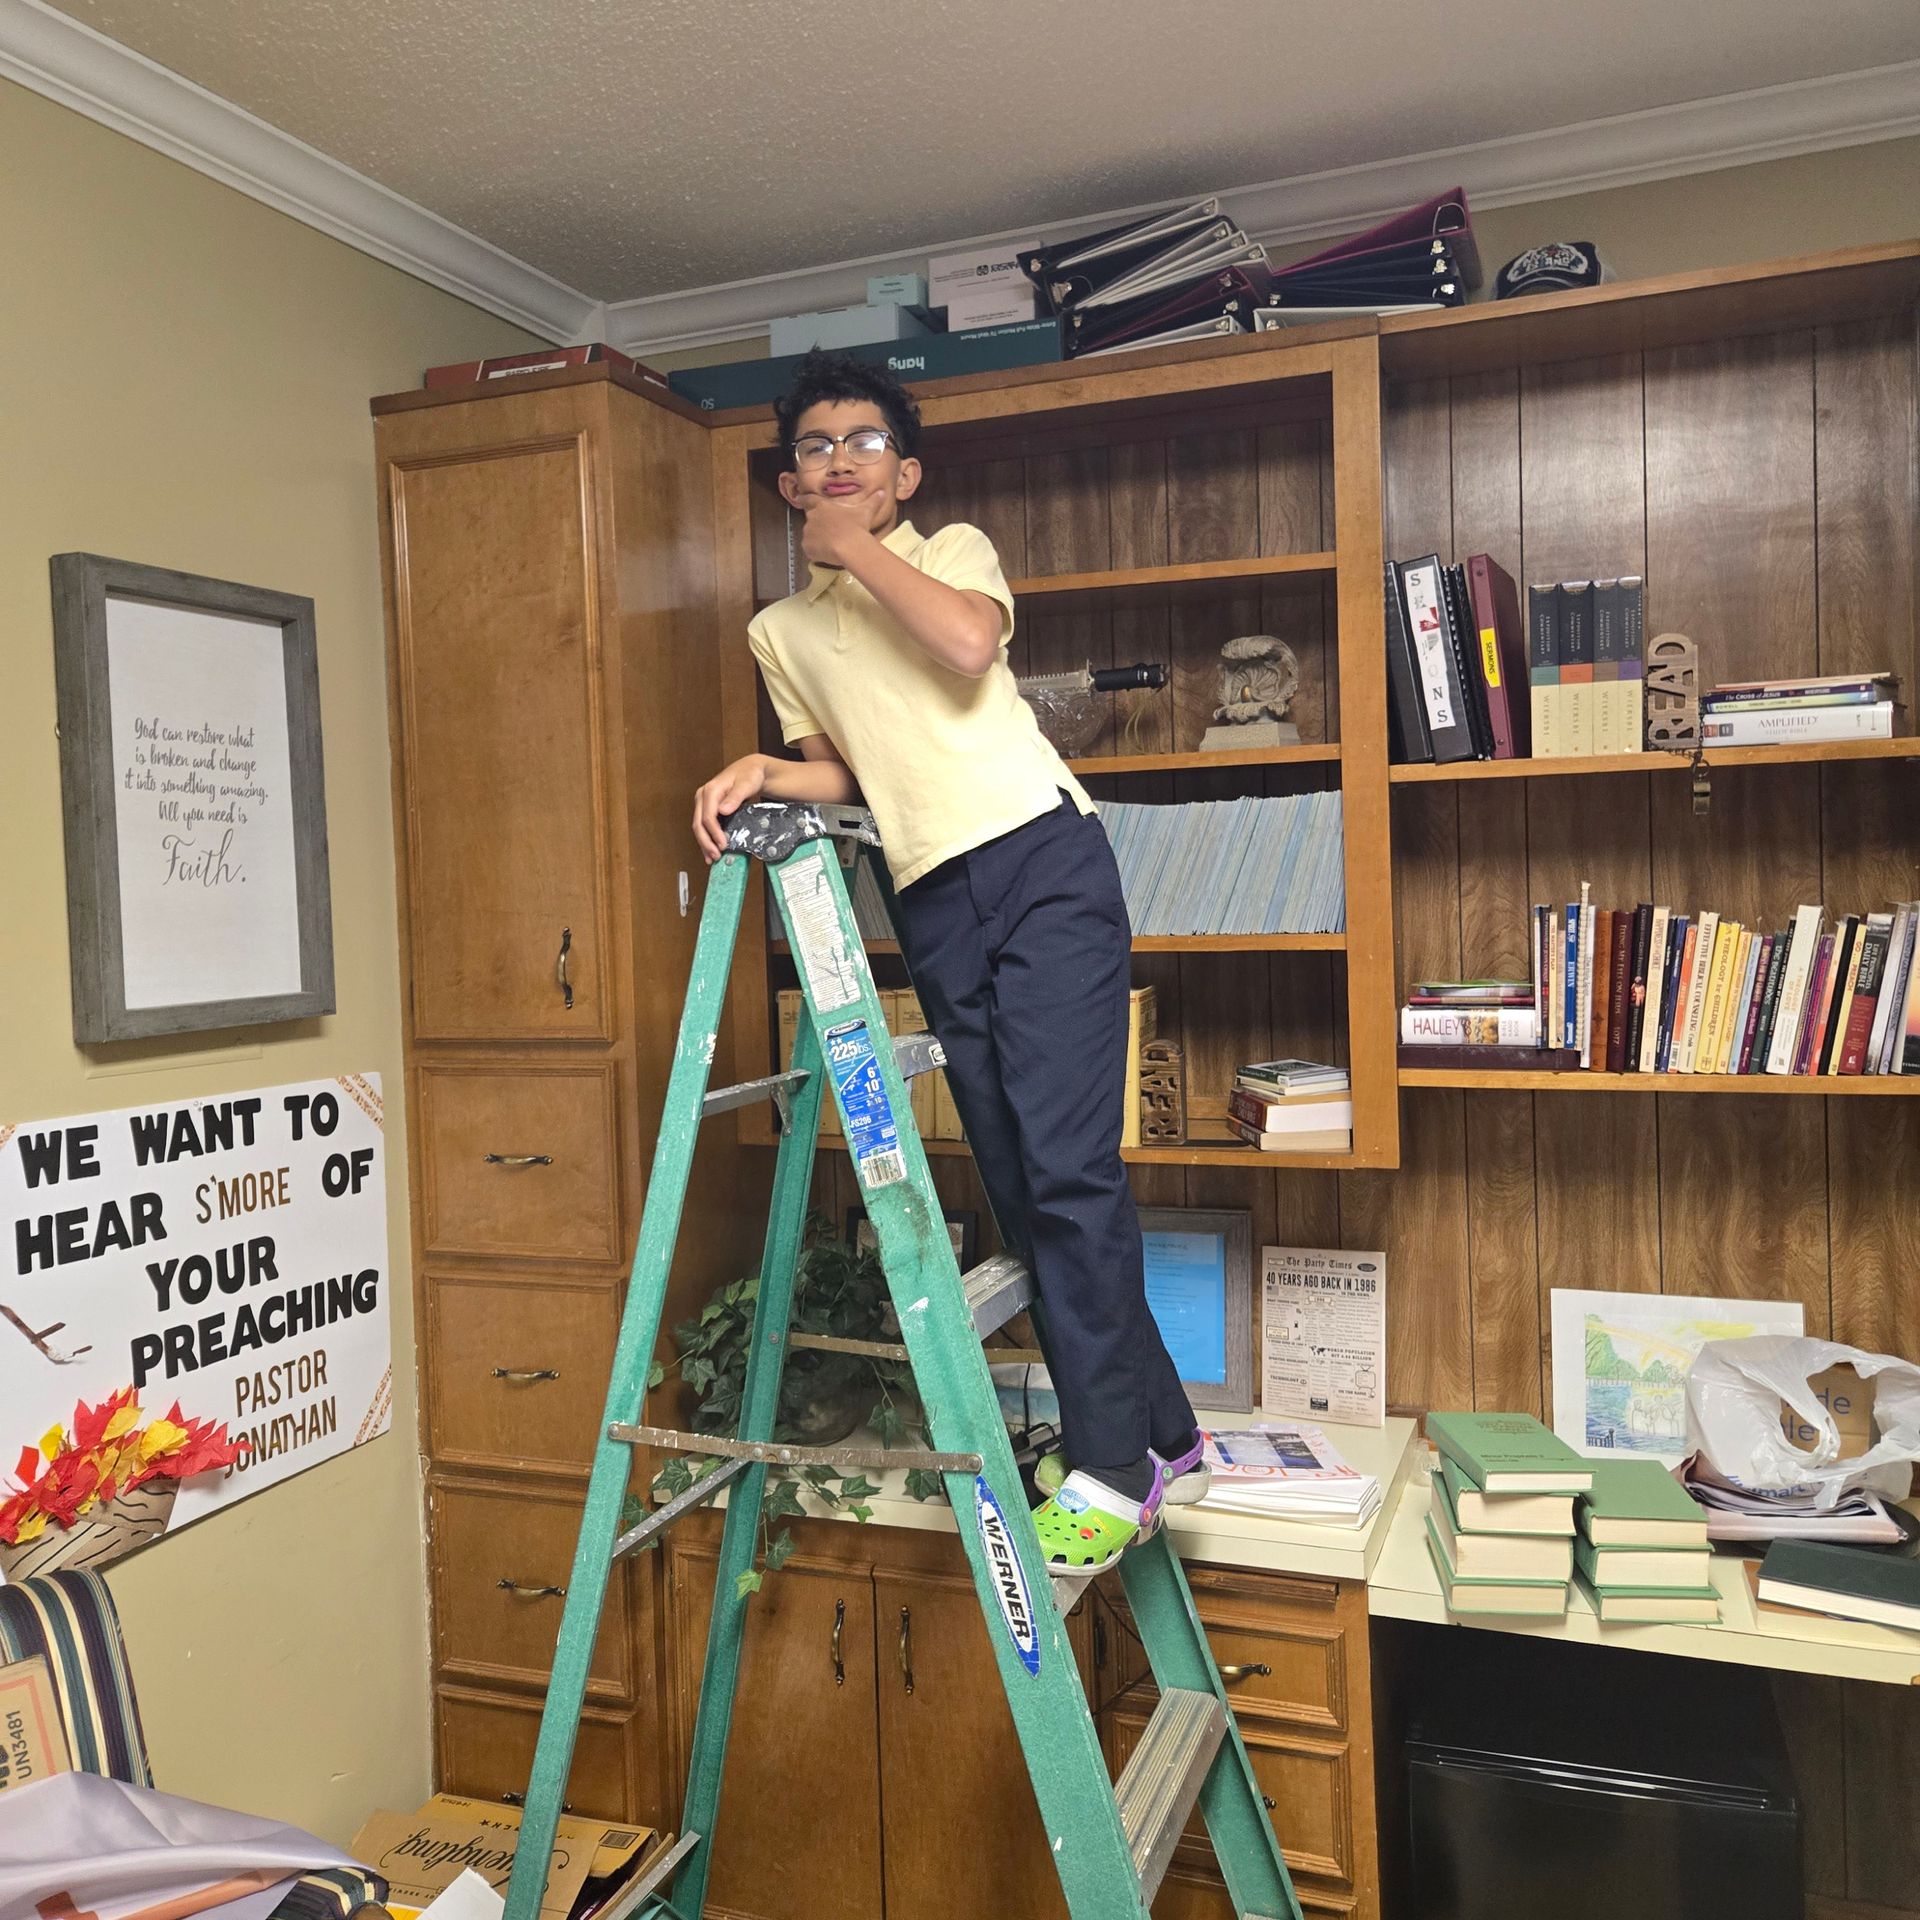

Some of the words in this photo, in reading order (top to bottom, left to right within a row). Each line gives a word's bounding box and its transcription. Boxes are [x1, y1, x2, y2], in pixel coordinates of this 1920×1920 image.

[888, 356, 924, 370] hang
[1485, 642, 1496, 675] SERMONS
[1648, 633, 1699, 747] READ
[135, 717, 160, 740] God
[162, 728, 183, 741] can
[187, 722, 225, 745] restore
[229, 725, 255, 748] what
[1759, 716, 1817, 728] AMPLIFIED
[136, 746, 146, 765] is
[151, 744, 189, 767] broken
[193, 749, 216, 770] and
[220, 749, 256, 780] change
[125, 768, 134, 790] it
[137, 769, 156, 791] into
[161, 772, 216, 803] something
[220, 782, 269, 806] amazing.
[159, 801, 179, 822] All
[183, 803, 204, 830] you
[208, 802, 234, 823] need
[238, 807, 248, 824] is
[163, 828, 246, 887] Faith.
[1618, 950, 1626, 962] MY
[1700, 924, 1712, 959] EFFECTIVE
[1855, 942, 1862, 952] GO
[1862, 942, 1872, 966] DAILY
[1568, 961, 1576, 988] ERWIN
[1696, 961, 1706, 990] BIBLICAL
[1718, 937, 1731, 982] THEOLOGY
[1866, 958, 1878, 990] PRINCIPLES
[1616, 981, 1623, 993] ON
[1857, 968, 1868, 989] BIBLE
[1614, 994, 1622, 1014] JESUS
[1690, 991, 1701, 1031] COUNSELING
[1708, 994, 1720, 1035] CHILDREN
[1413, 1018, 1472, 1036] HALLEY'S
[1140, 1040, 1186, 1145] READ
[18, 1125, 100, 1189] WE
[130, 1097, 261, 1166] WANT
[284, 1092, 339, 1141] TO
[16, 1192, 167, 1275] HEAR
[196, 1167, 291, 1224] S'MORE
[321, 1148, 373, 1198] OF
[146, 1236, 279, 1312] YOUR
[1286, 1257, 1300, 1267] The
[1304, 1258, 1325, 1268] Party
[1329, 1260, 1352, 1270] Times
[1266, 1272, 1276, 1285] 40
[1278, 1273, 1302, 1286] YEARS
[1304, 1275, 1318, 1288] AGO
[1321, 1276, 1341, 1290] BACK
[1344, 1278, 1352, 1291] IN
[1355, 1279, 1376, 1292] 1986
[131, 1269, 378, 1389] PREACHING
[235, 1349, 328, 1418] PASTOR
[1816, 1388, 1850, 1414] de
[1781, 1415, 1816, 1441] le
[984, 1516, 1030, 1639] WERNER
[6, 1710, 32, 1780] UN3481
